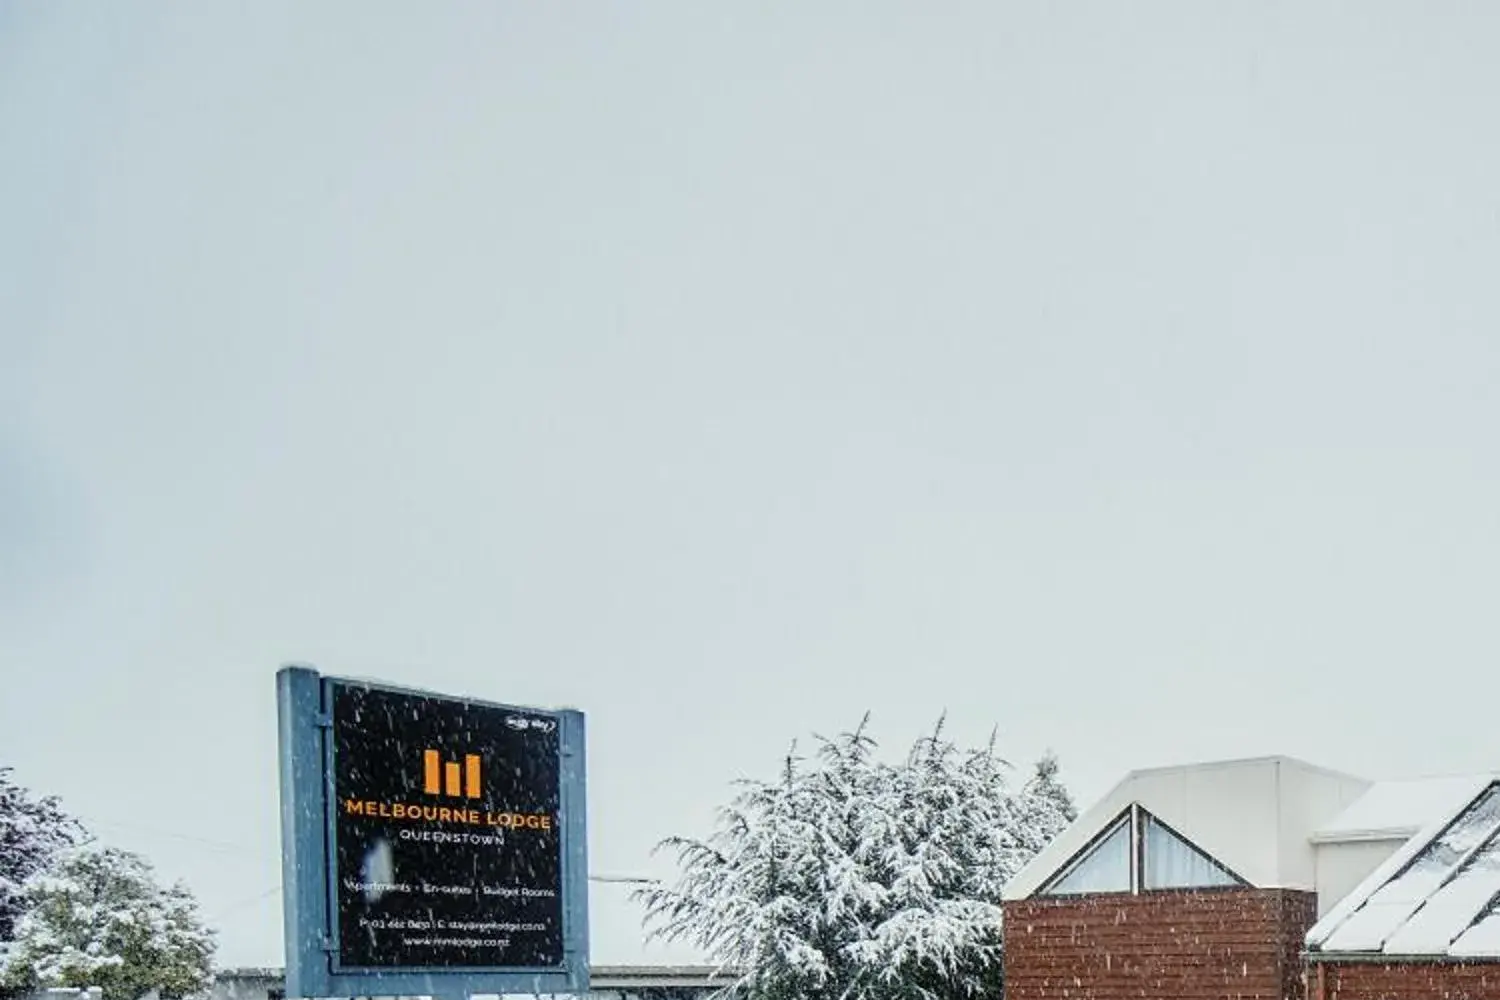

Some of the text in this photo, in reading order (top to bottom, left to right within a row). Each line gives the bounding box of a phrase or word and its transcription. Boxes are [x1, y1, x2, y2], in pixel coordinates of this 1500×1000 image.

[345, 800, 551, 829] MELBOURNE LODGE
[399, 829, 505, 846] QUEENSTOWN
[521, 887, 555, 897] Rooms
